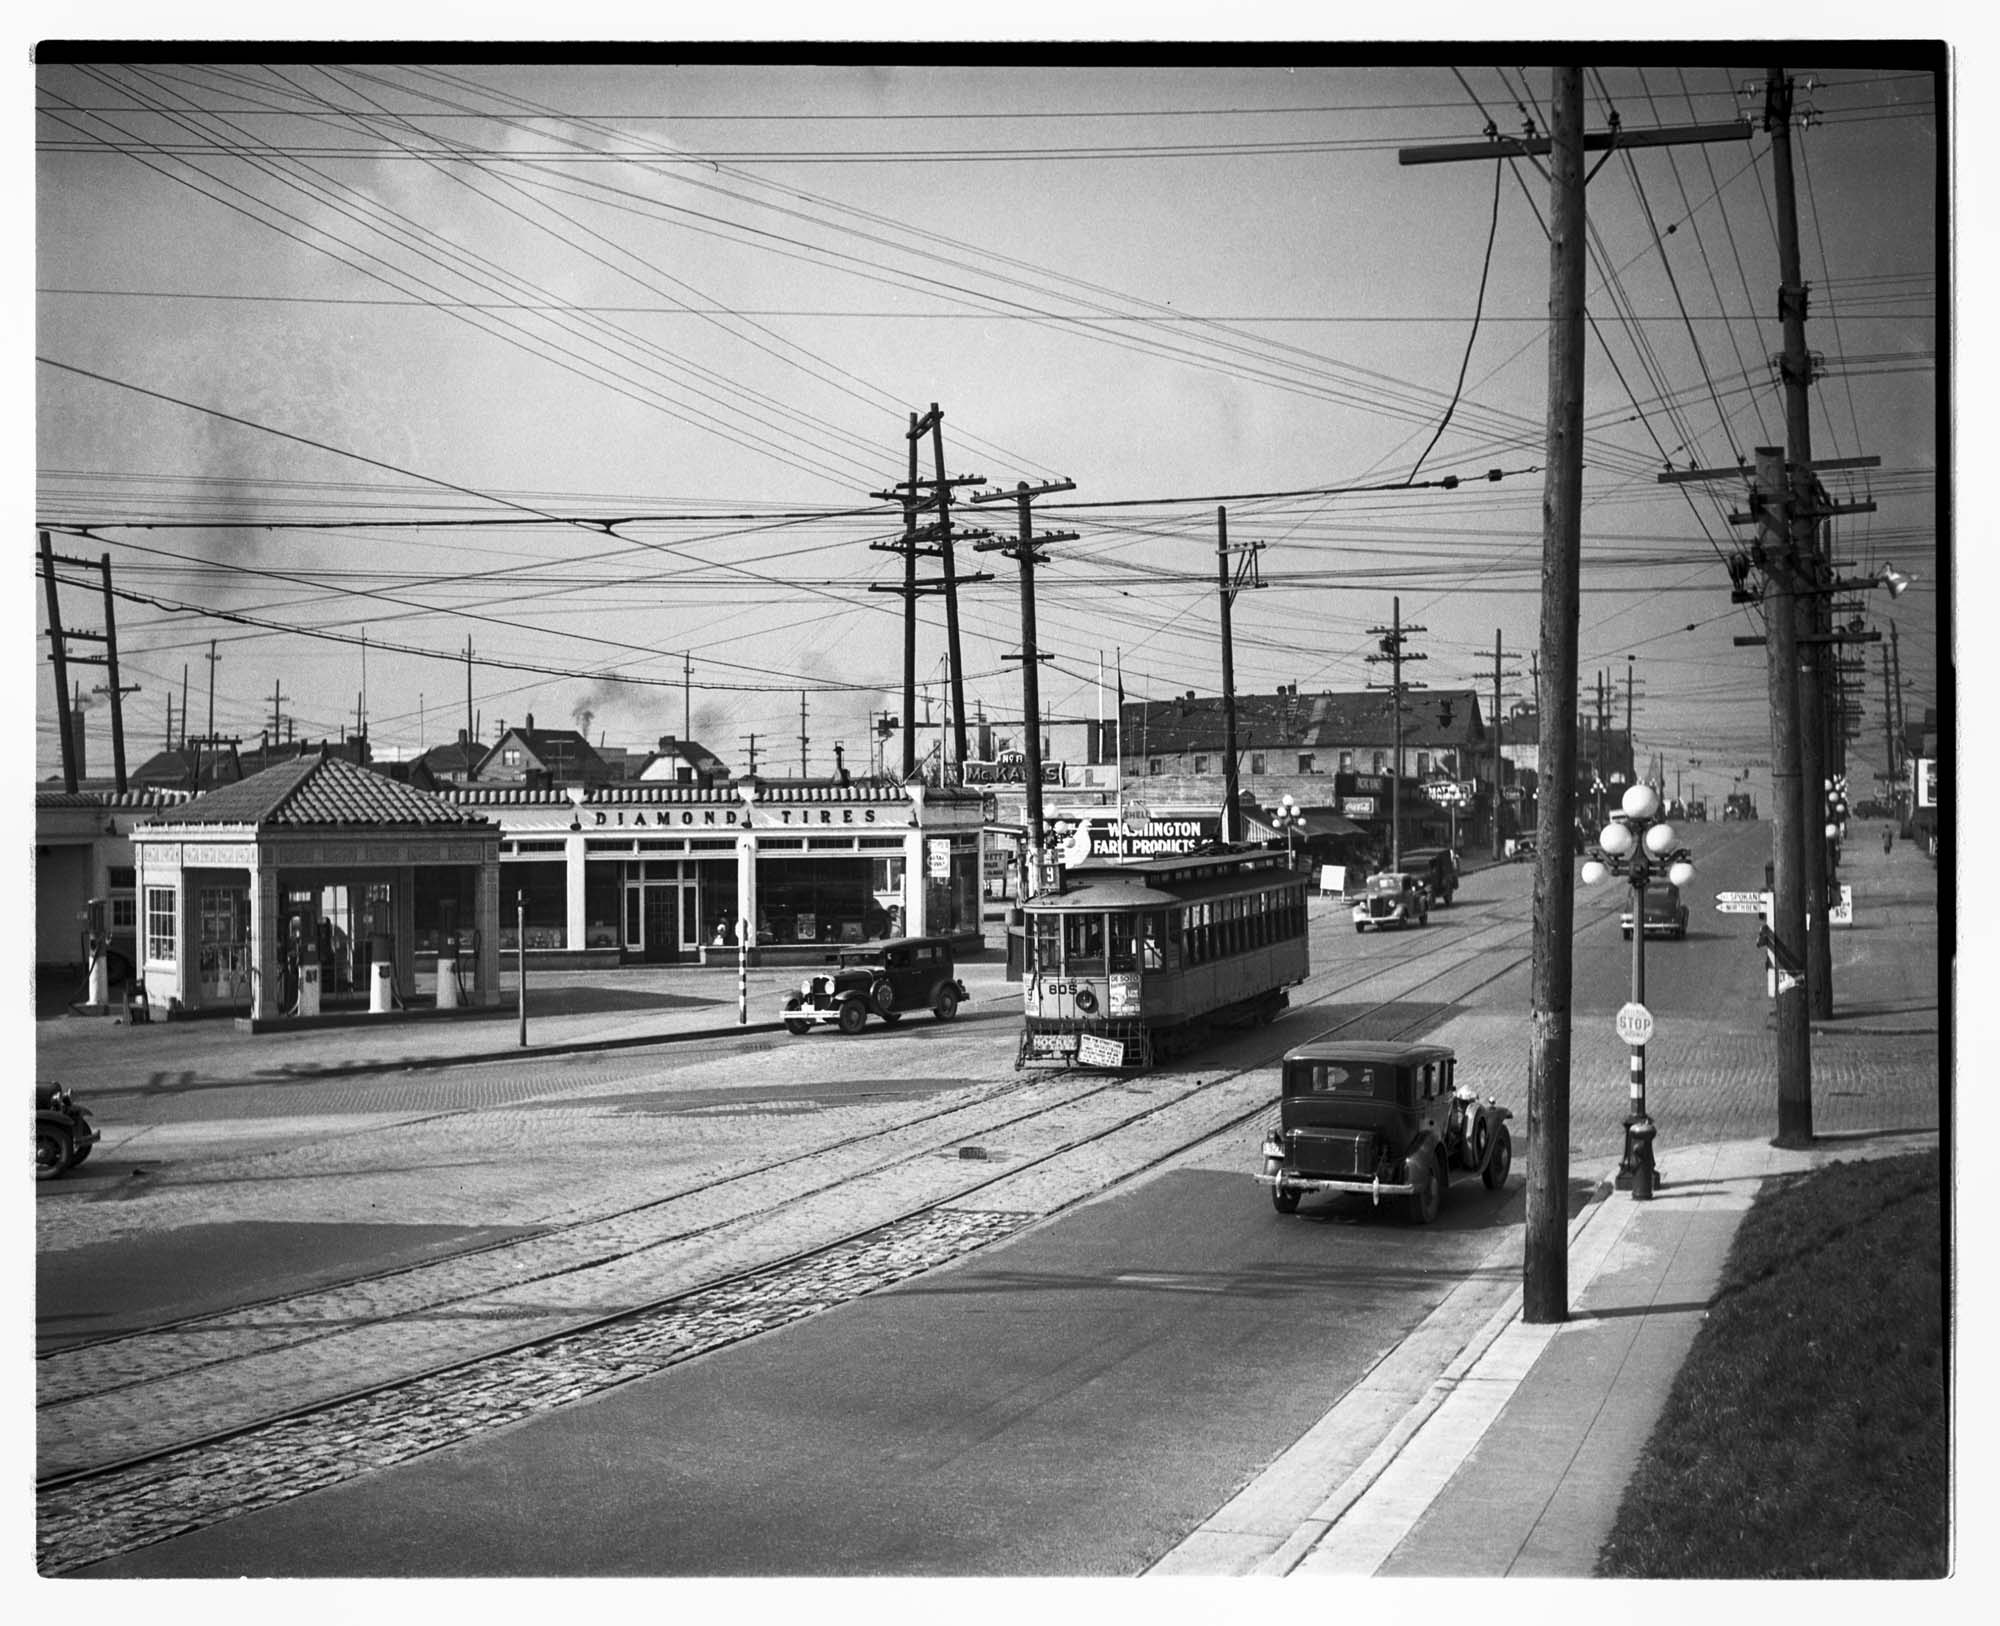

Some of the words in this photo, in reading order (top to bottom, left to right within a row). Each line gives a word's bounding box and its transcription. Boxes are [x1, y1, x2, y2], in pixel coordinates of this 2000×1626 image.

[595, 810, 738, 826] DIAMOND
[781, 810, 876, 823] TIRES
[1123, 810, 1151, 819] SHELL
[1132, 839, 1196, 855] PRODUCTS
[1046, 866, 1054, 882] 9
[1619, 1016, 1651, 1031] STOP
